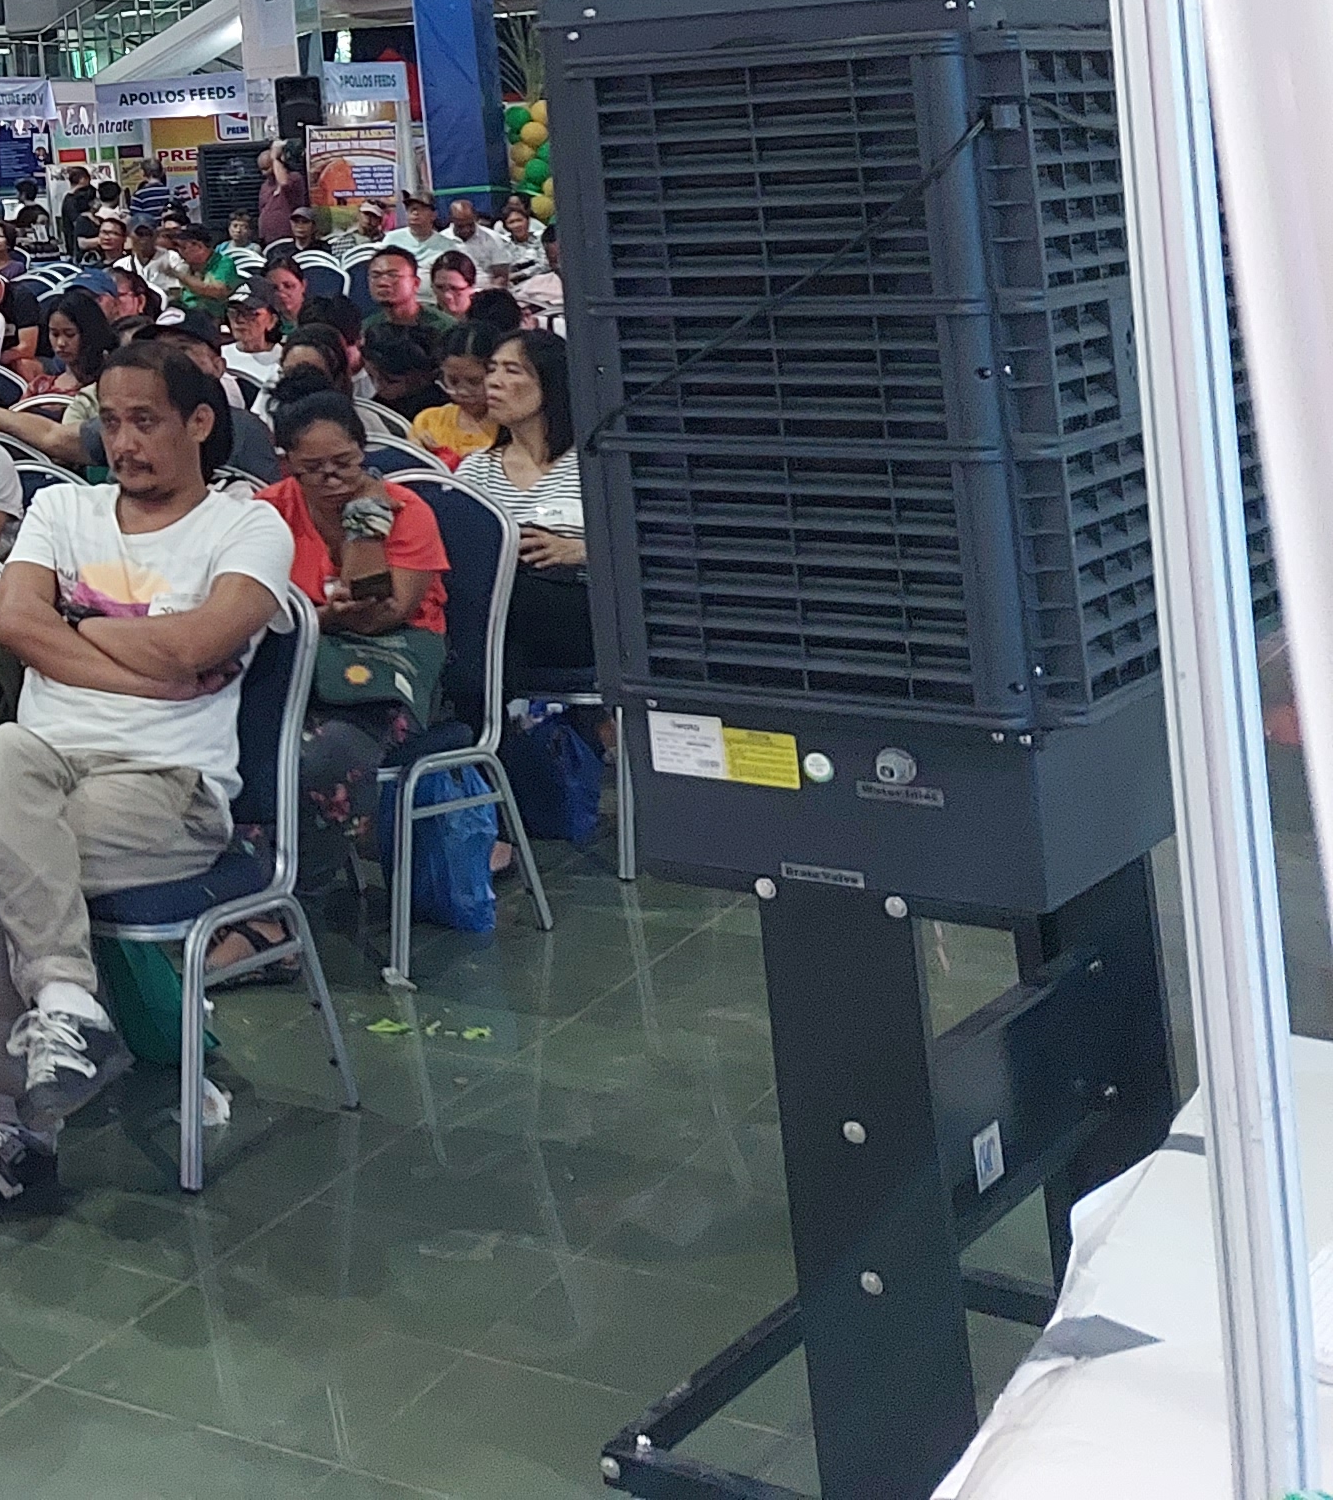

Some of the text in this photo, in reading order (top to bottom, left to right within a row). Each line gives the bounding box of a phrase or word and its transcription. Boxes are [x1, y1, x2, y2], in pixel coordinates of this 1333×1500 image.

[374, 74, 397, 88] FEEDS
[22, 93, 37, 106] RFO
[38, 93, 44, 105] V
[119, 85, 236, 107] APOLLOS FEEDS
[157, 149, 198, 162] PRE
